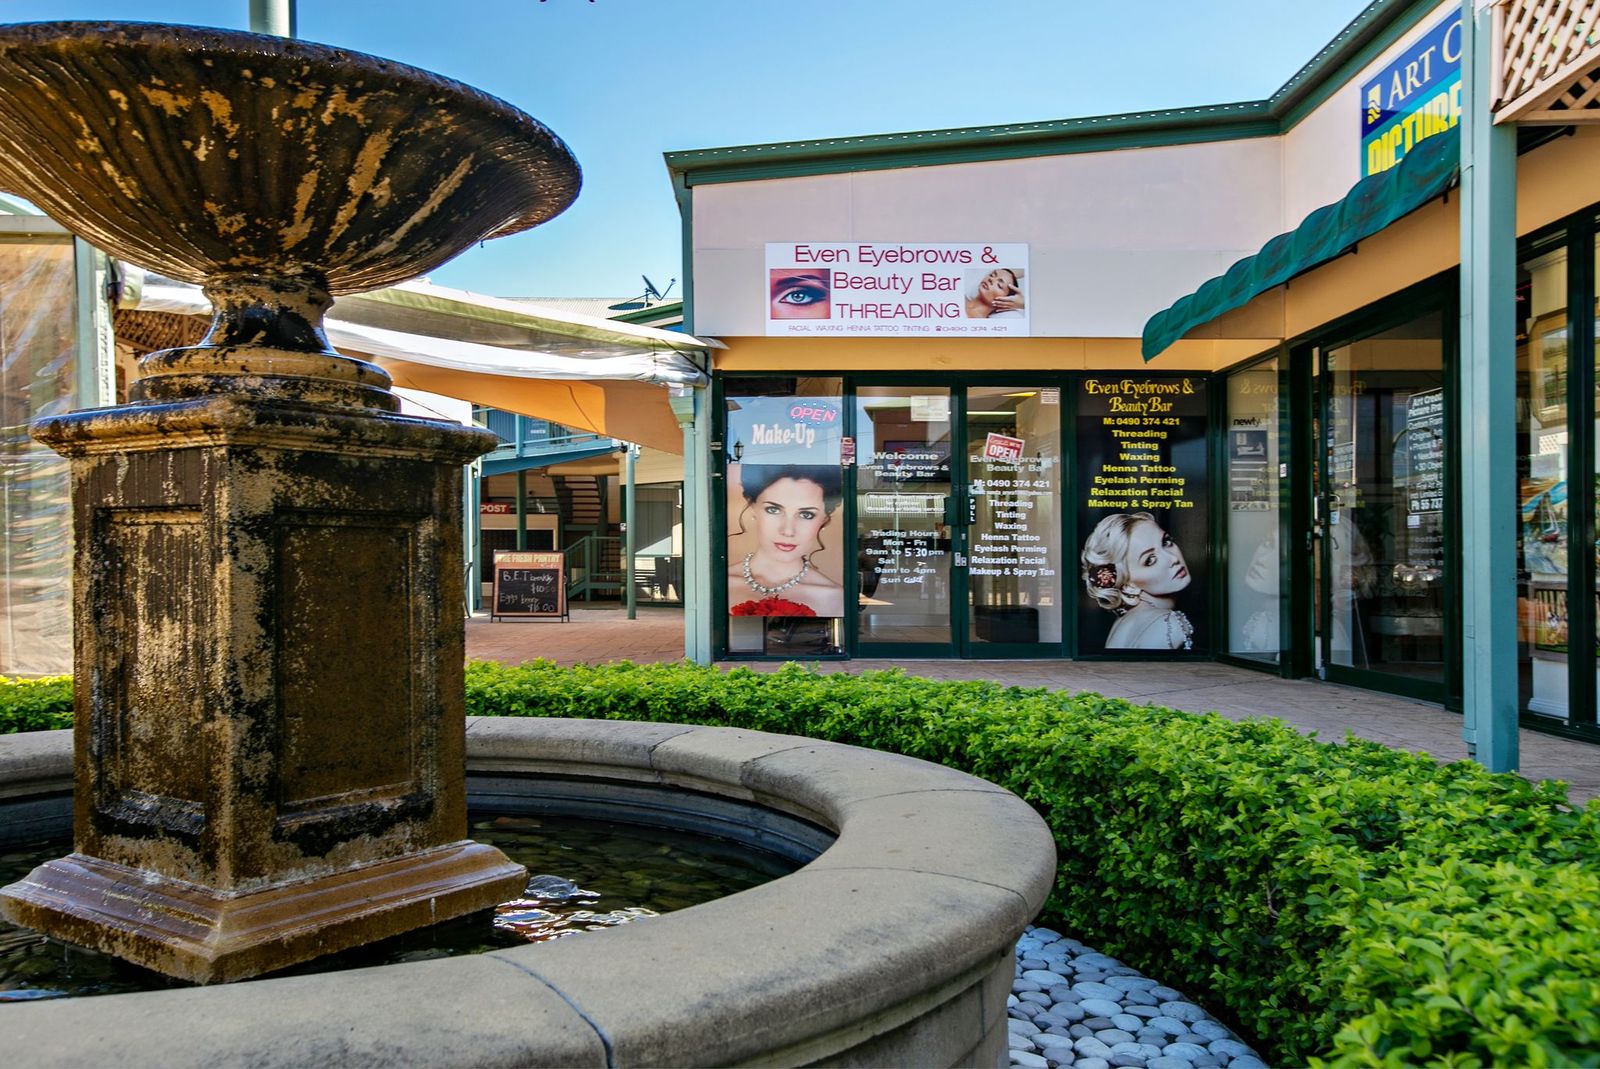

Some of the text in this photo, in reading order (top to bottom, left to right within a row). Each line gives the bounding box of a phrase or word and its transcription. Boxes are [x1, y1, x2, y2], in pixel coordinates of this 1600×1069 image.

[1386, 46, 1436, 110] ART
[794, 245, 999, 267] Even Eyebrows &
[833, 272, 961, 295] Beauty Bar
[835, 303, 961, 319] THREADING
[1085, 378, 1195, 399] Even Eyebrows &
[1108, 396, 1173, 415] Beauty Bar
[1412, 397, 1424, 409] Art
[790, 406, 837, 422] OPEN
[1103, 417, 1180, 426] M: 0490 374 421
[751, 424, 816, 448] Make-Up
[1111, 429, 1168, 439] Threading
[1120, 441, 1159, 450] Tinting
[874, 451, 939, 461] Welcome
[989, 444, 1017, 460] OPEN
[1119, 453, 1160, 463] Waxing
[887, 463, 939, 472] Eyebrows
[986, 464, 1024, 472] Beauty
[1102, 464, 1176, 473] Henna Tattoo
[973, 479, 1050, 488] M: 0490 374 421
[1094, 475, 1185, 486] Eyelash Perming
[1090, 487, 1184, 497] Relaxation Facial
[480, 504, 507, 513] POST
[989, 499, 1034, 508] Threading
[1088, 499, 1193, 510] Makeup & Spray Tan
[995, 511, 1026, 519] Tinting
[995, 522, 1027, 531] Waxing
[870, 530, 907, 538] Trading
[904, 548, 928, 557] 5:30
[974, 545, 1047, 554] Eyelash Perming
[972, 556, 1046, 564] Relaxation Facial
[874, 566, 897, 574] 9am
[969, 567, 1055, 577] Makeup & Spray Tan
